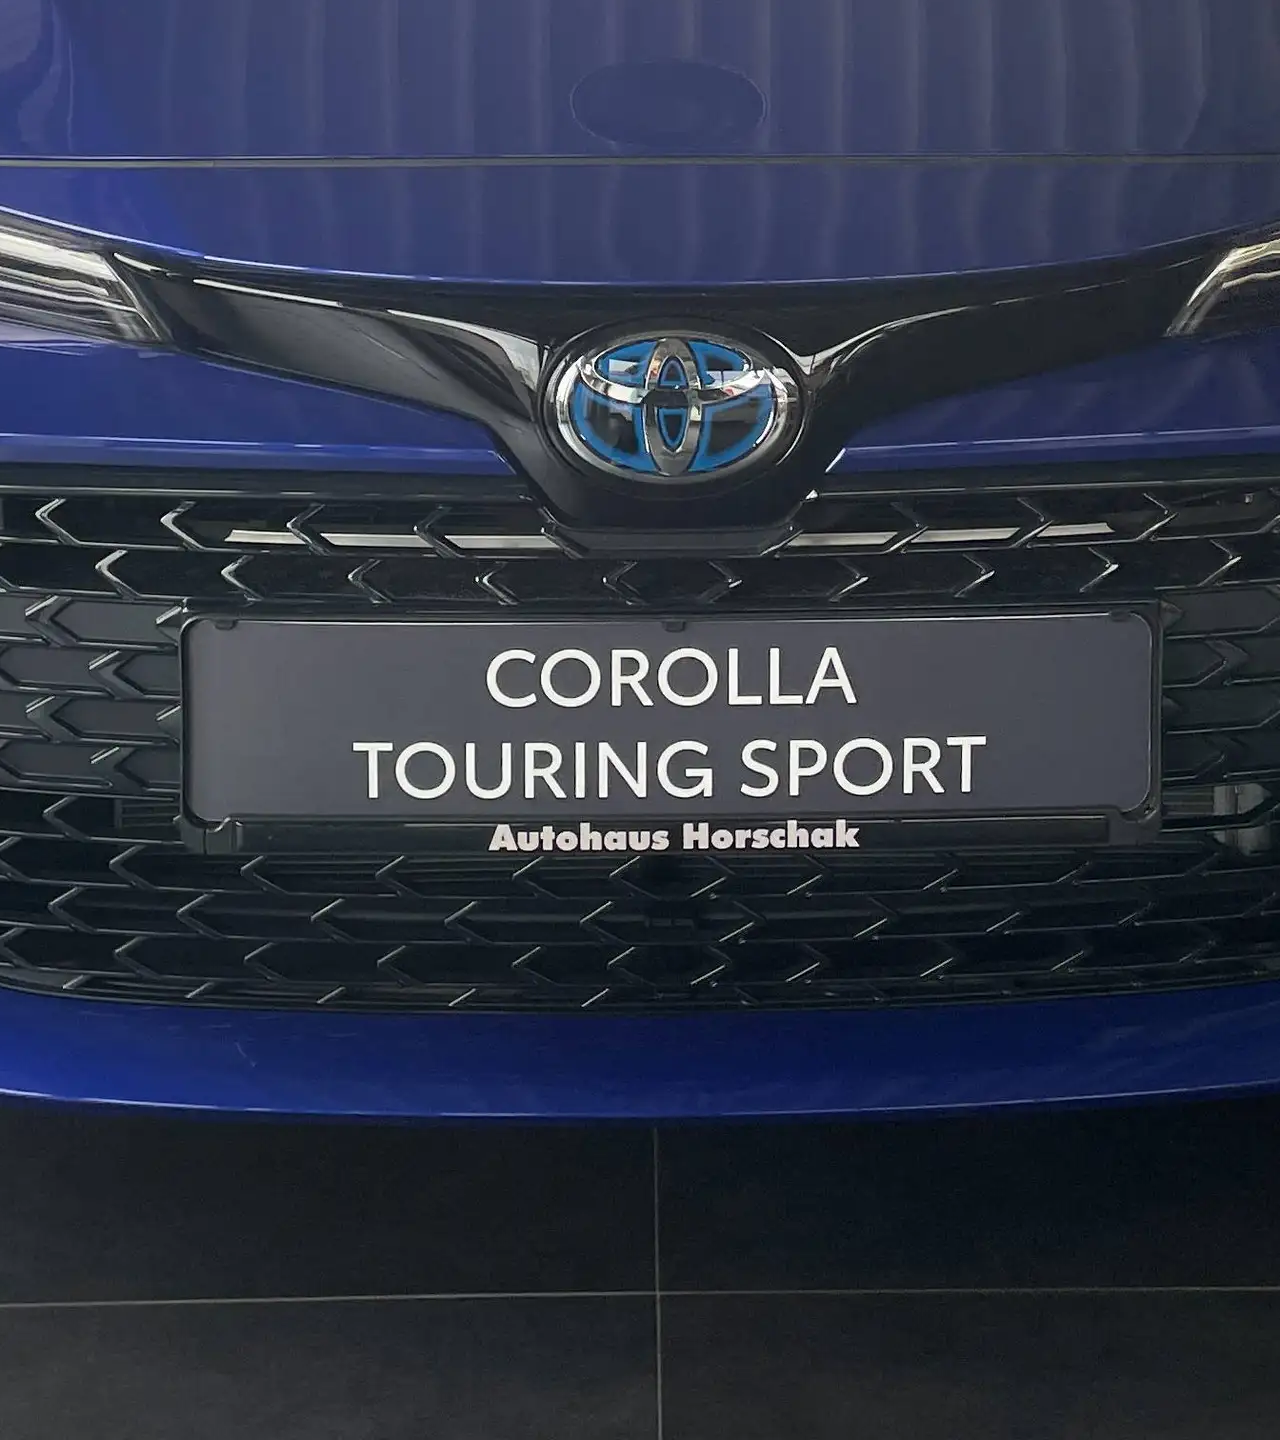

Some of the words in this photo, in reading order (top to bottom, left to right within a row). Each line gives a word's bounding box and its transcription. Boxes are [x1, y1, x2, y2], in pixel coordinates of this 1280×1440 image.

[486, 645, 858, 709] COROLLA
[351, 739, 714, 800] TOURING
[739, 734, 988, 799] SPORT
[488, 822, 671, 852] Autohaus
[681, 818, 861, 850] Horschak
